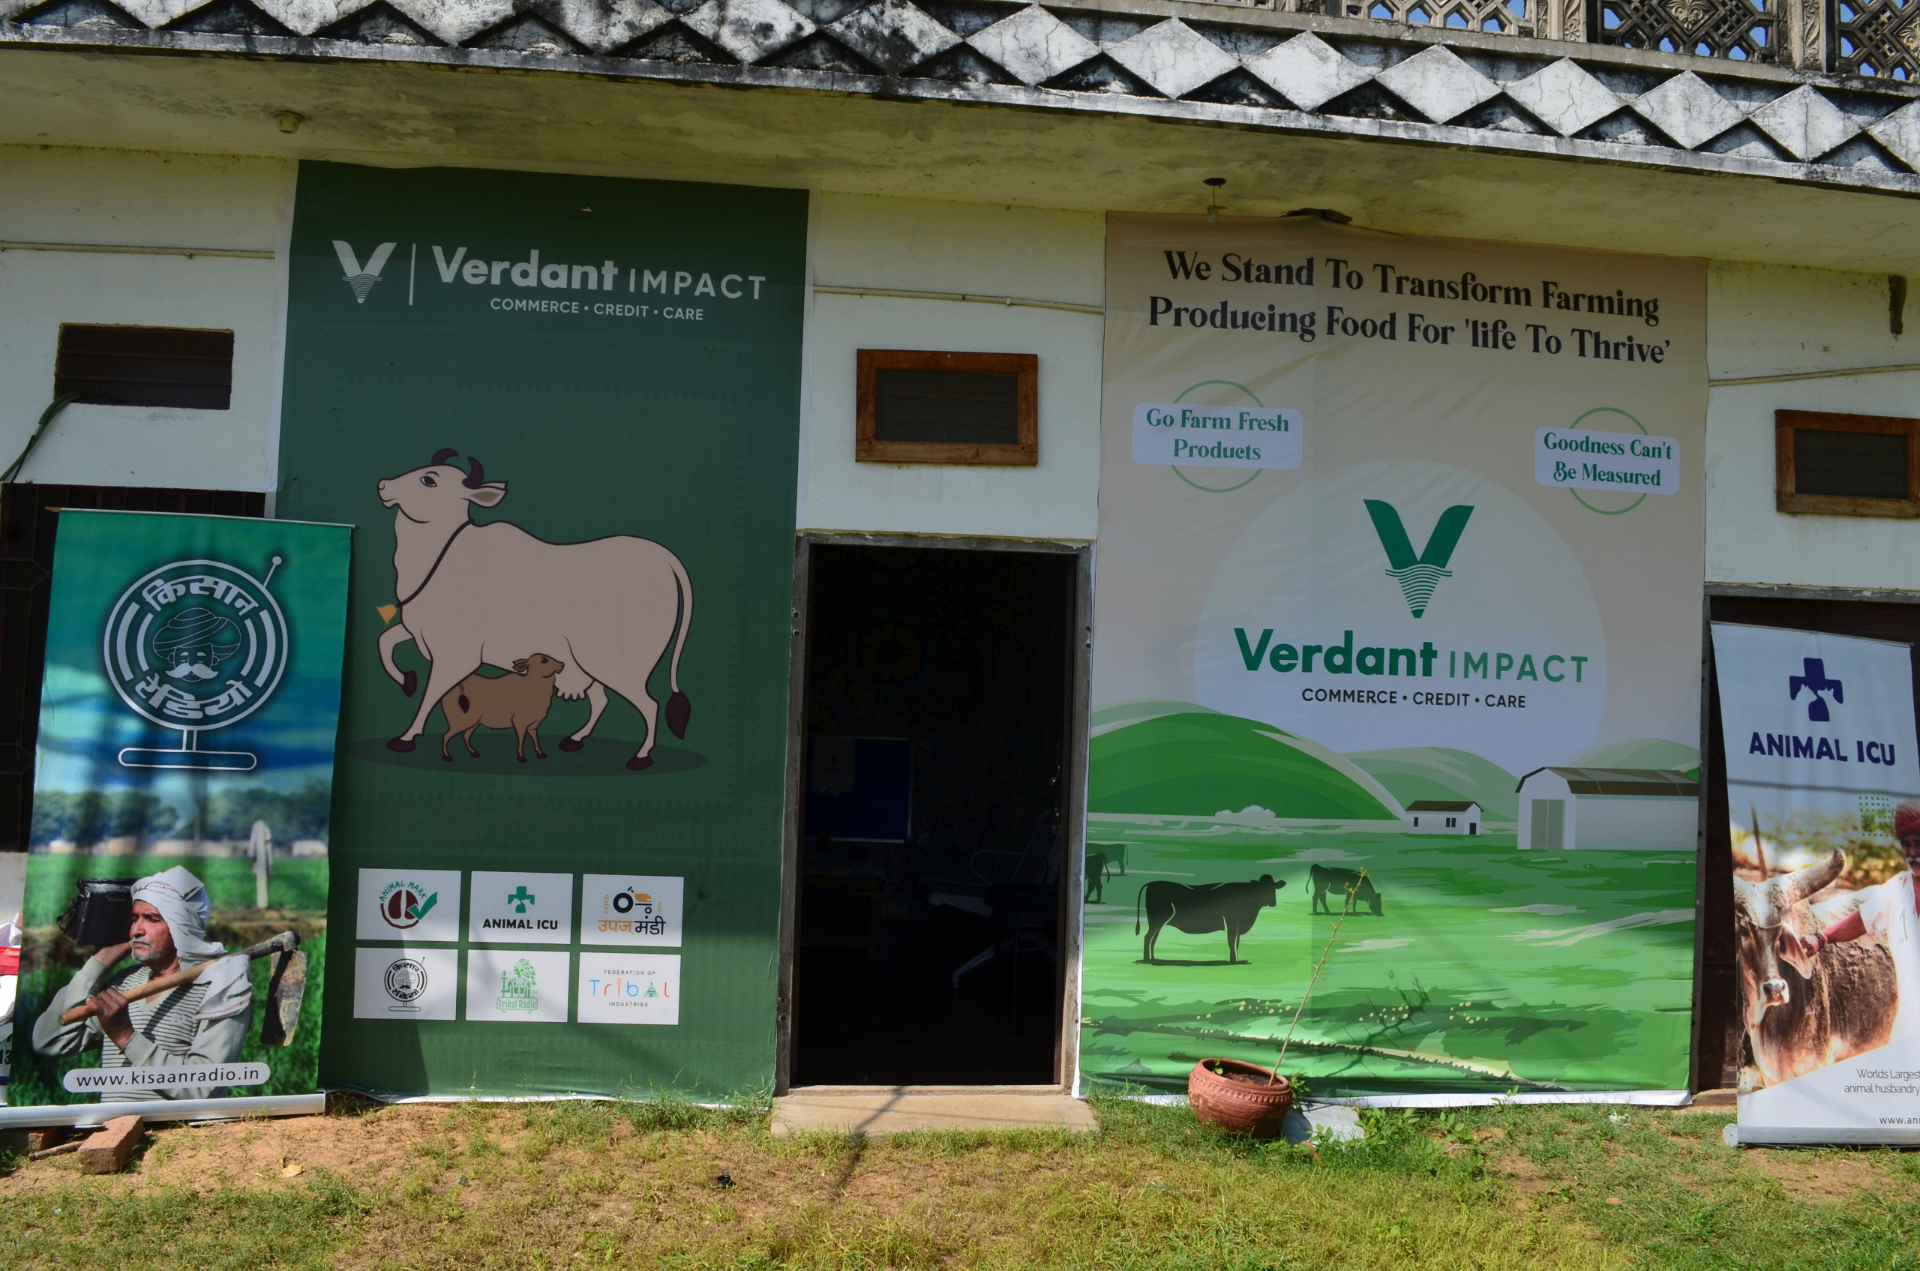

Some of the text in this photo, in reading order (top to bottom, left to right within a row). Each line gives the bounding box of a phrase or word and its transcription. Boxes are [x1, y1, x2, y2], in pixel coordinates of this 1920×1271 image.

[432, 245, 767, 300] Verdant IMPACT
[1164, 250, 1660, 327] We Stand To Transform Farming
[490, 298, 704, 321] COMMERCE CREDIT CARE
[1148, 296, 1316, 342] Producing
[1326, 305, 1397, 341] Food
[1407, 312, 1455, 345] For
[1525, 323, 1562, 354] To
[1146, 408, 1289, 433] Go Farm Fresh
[1173, 438, 1262, 461] Products
[1543, 432, 1672, 461] Goodness Can't
[1553, 461, 1661, 487] Be Measured
[141, 577, 260, 617] किसान
[1234, 628, 1588, 683] Verdant IMPACT
[134, 672, 253, 719] रेडियो
[1302, 688, 1526, 708] COMMERCE CREDIT CARE
[1749, 731, 1896, 766] ANIMAL ICU
[379, 880, 428, 902] ANIMAL MARK
[482, 918, 559, 930] ANIMAL ICU
[498, 999, 537, 1009] Tribal Radio
[76, 1066, 259, 1087] www.kisaanradio.in
[1856, 1068, 1889, 1079] Worlds
[1843, 1083, 1919, 1096] animal husbandry
